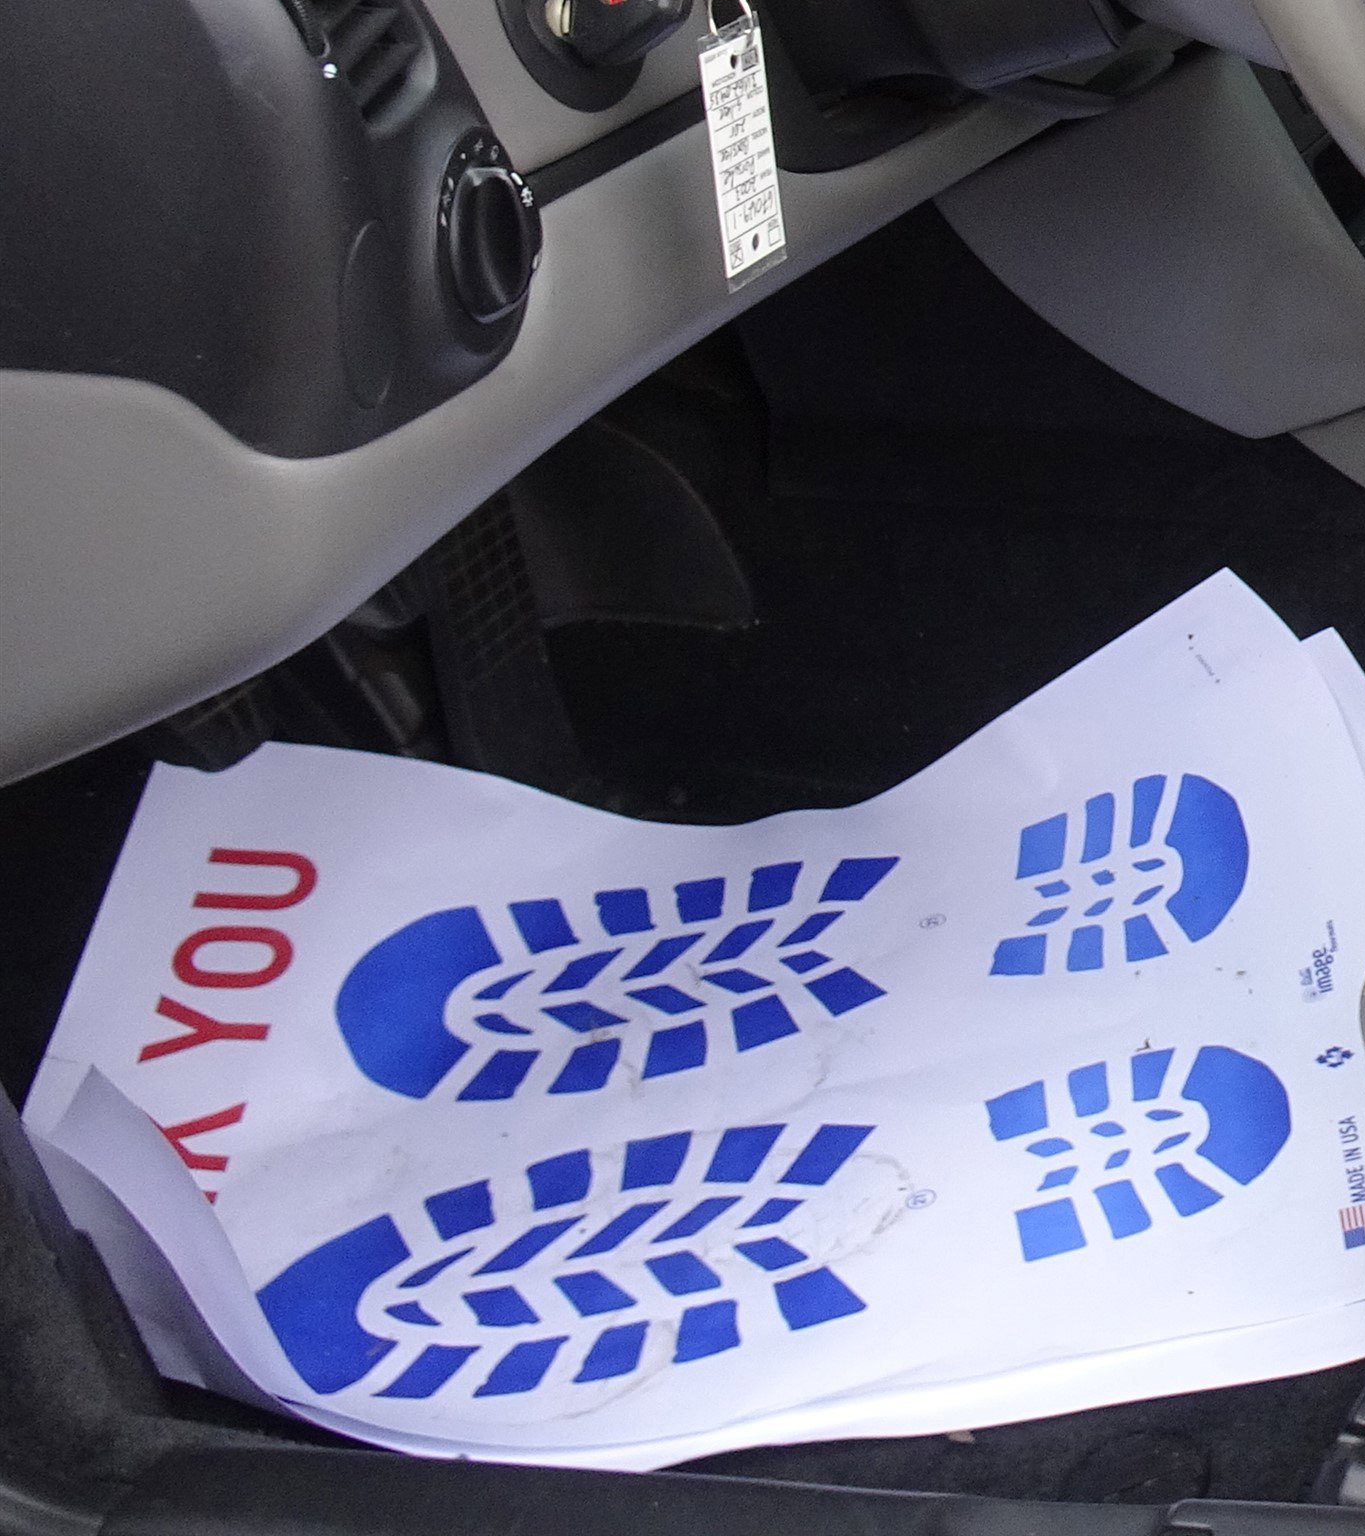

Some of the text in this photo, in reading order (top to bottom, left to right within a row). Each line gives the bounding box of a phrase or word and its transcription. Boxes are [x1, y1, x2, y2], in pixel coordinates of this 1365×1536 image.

[138, 847, 319, 1063] YOU
[1312, 947, 1334, 994] image
[1338, 1115, 1359, 1144] USA
[1342, 1146, 1363, 1163] IN
